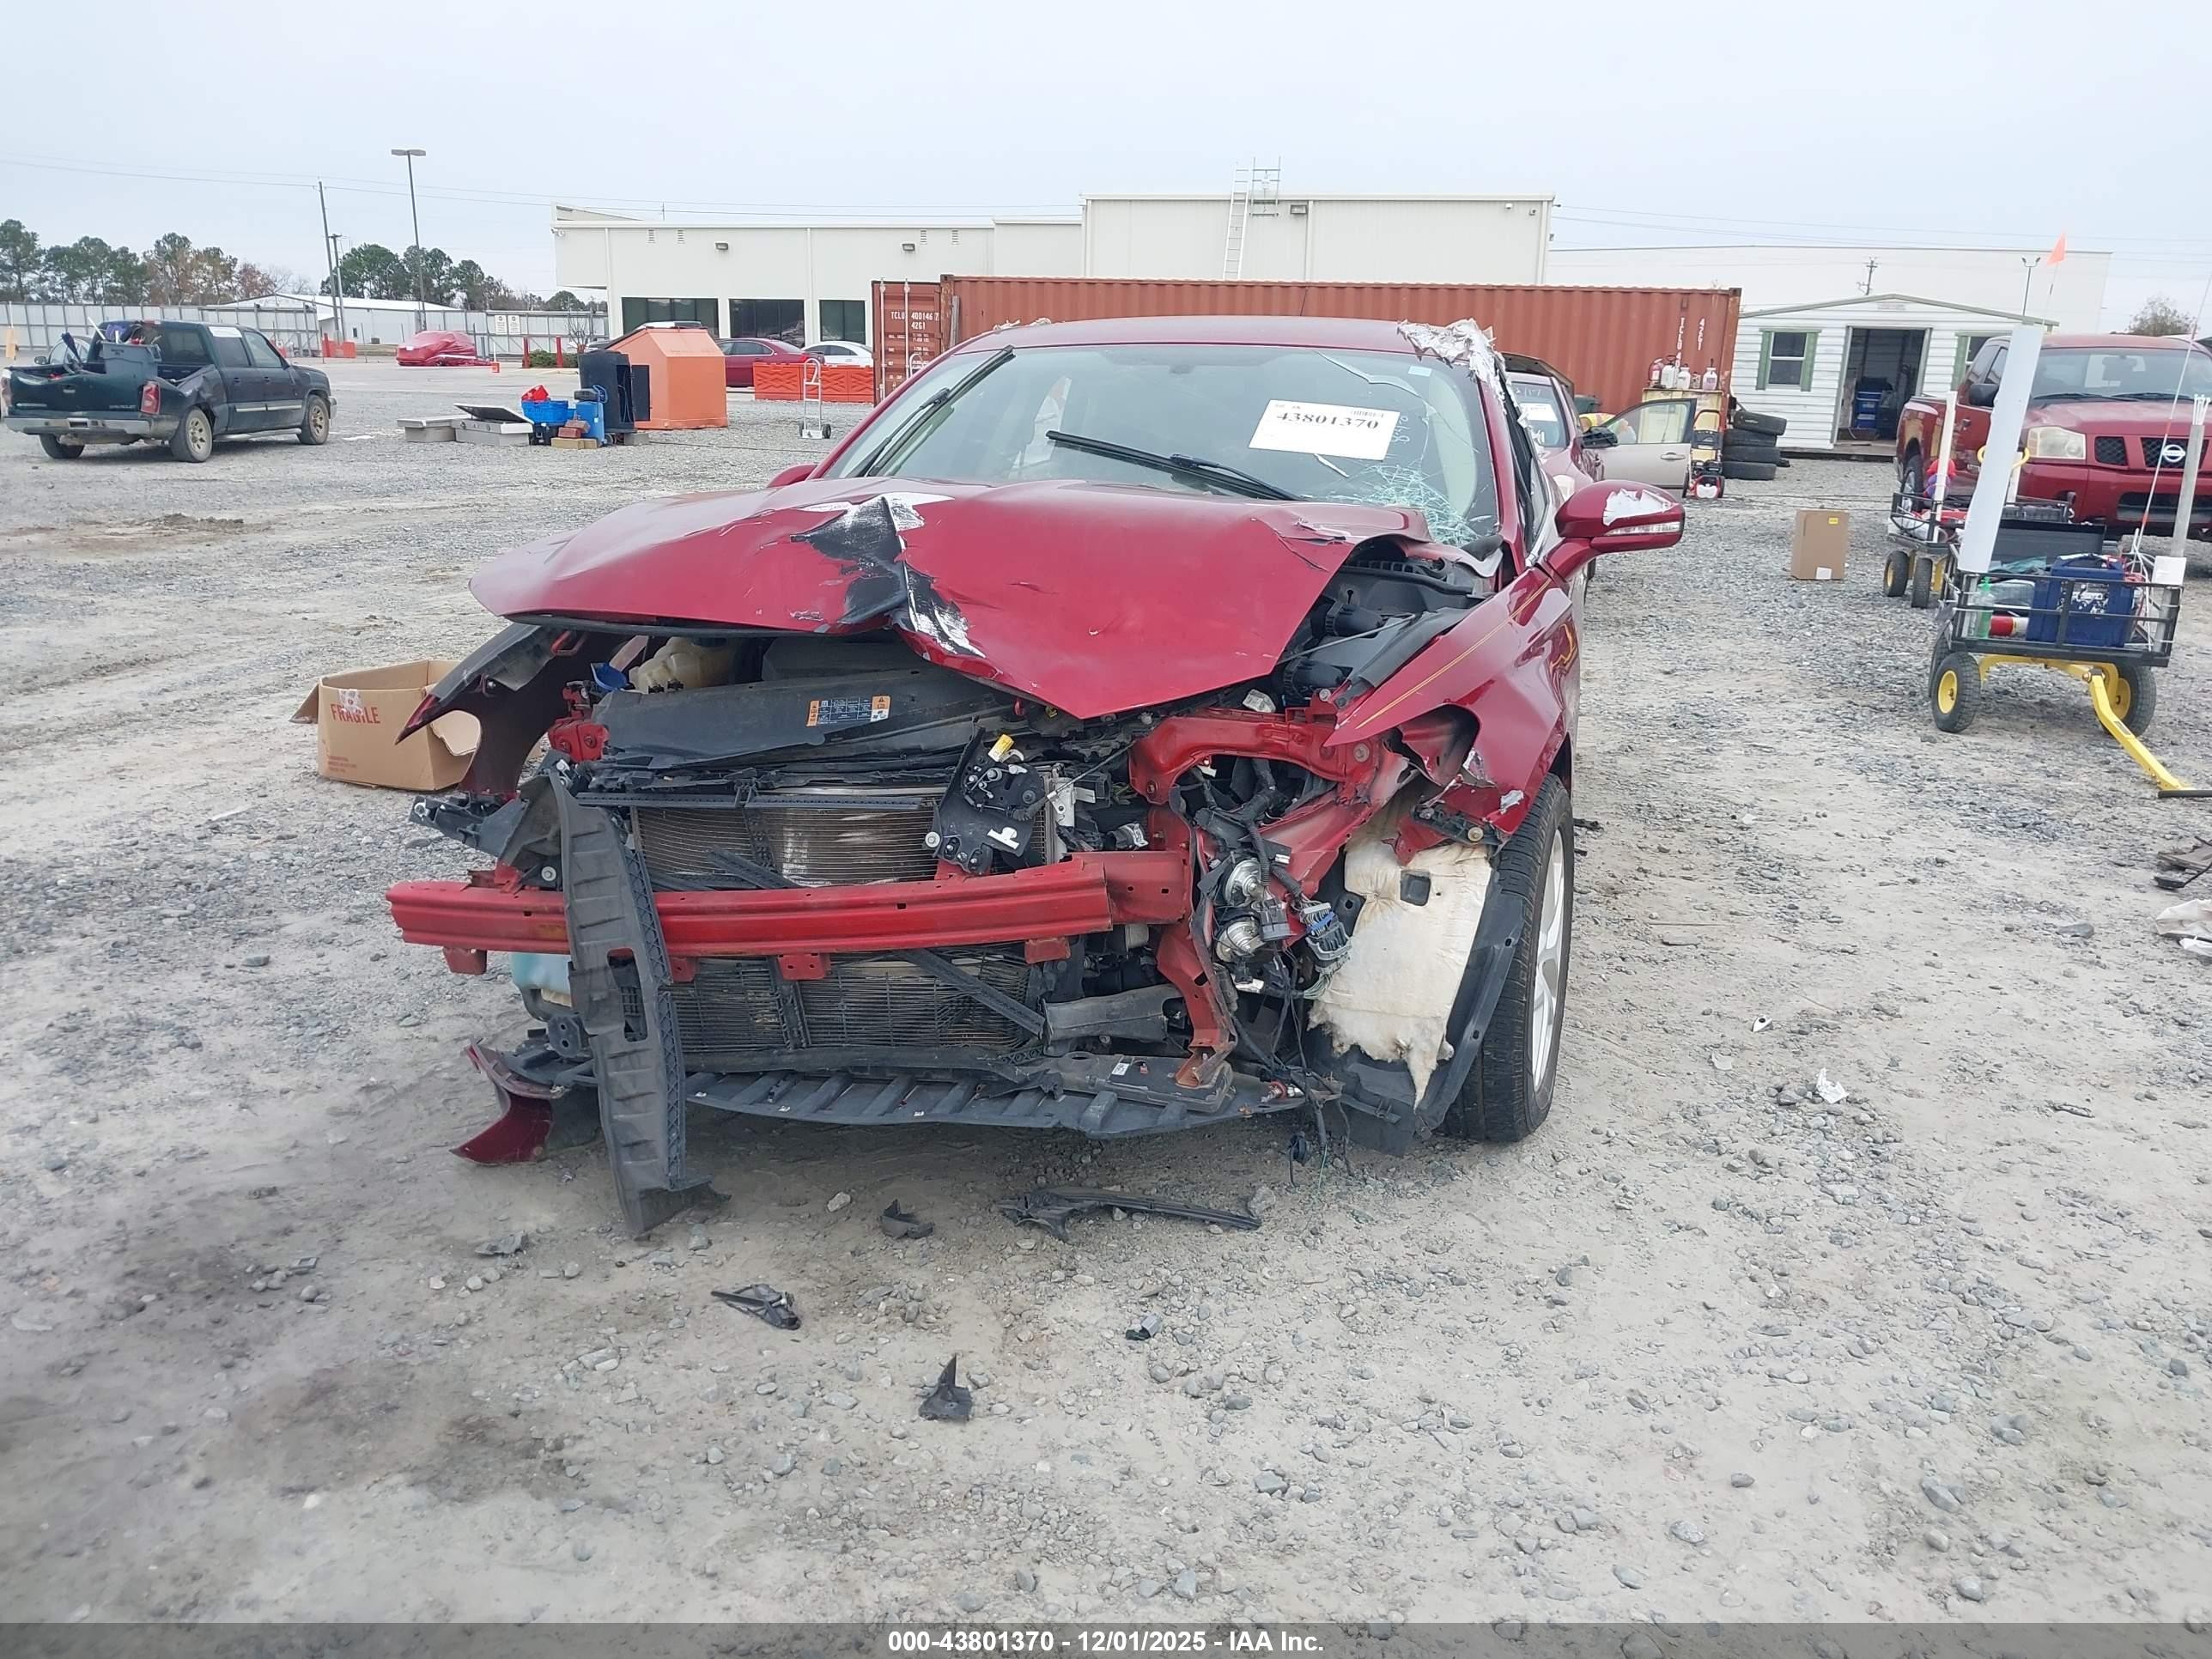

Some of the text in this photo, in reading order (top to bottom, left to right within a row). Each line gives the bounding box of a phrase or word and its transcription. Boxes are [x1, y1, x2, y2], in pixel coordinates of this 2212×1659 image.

[890, 311, 905, 319] TCLU
[1277, 411, 1379, 430] 43801370
[330, 703, 381, 724] FRAGILE
